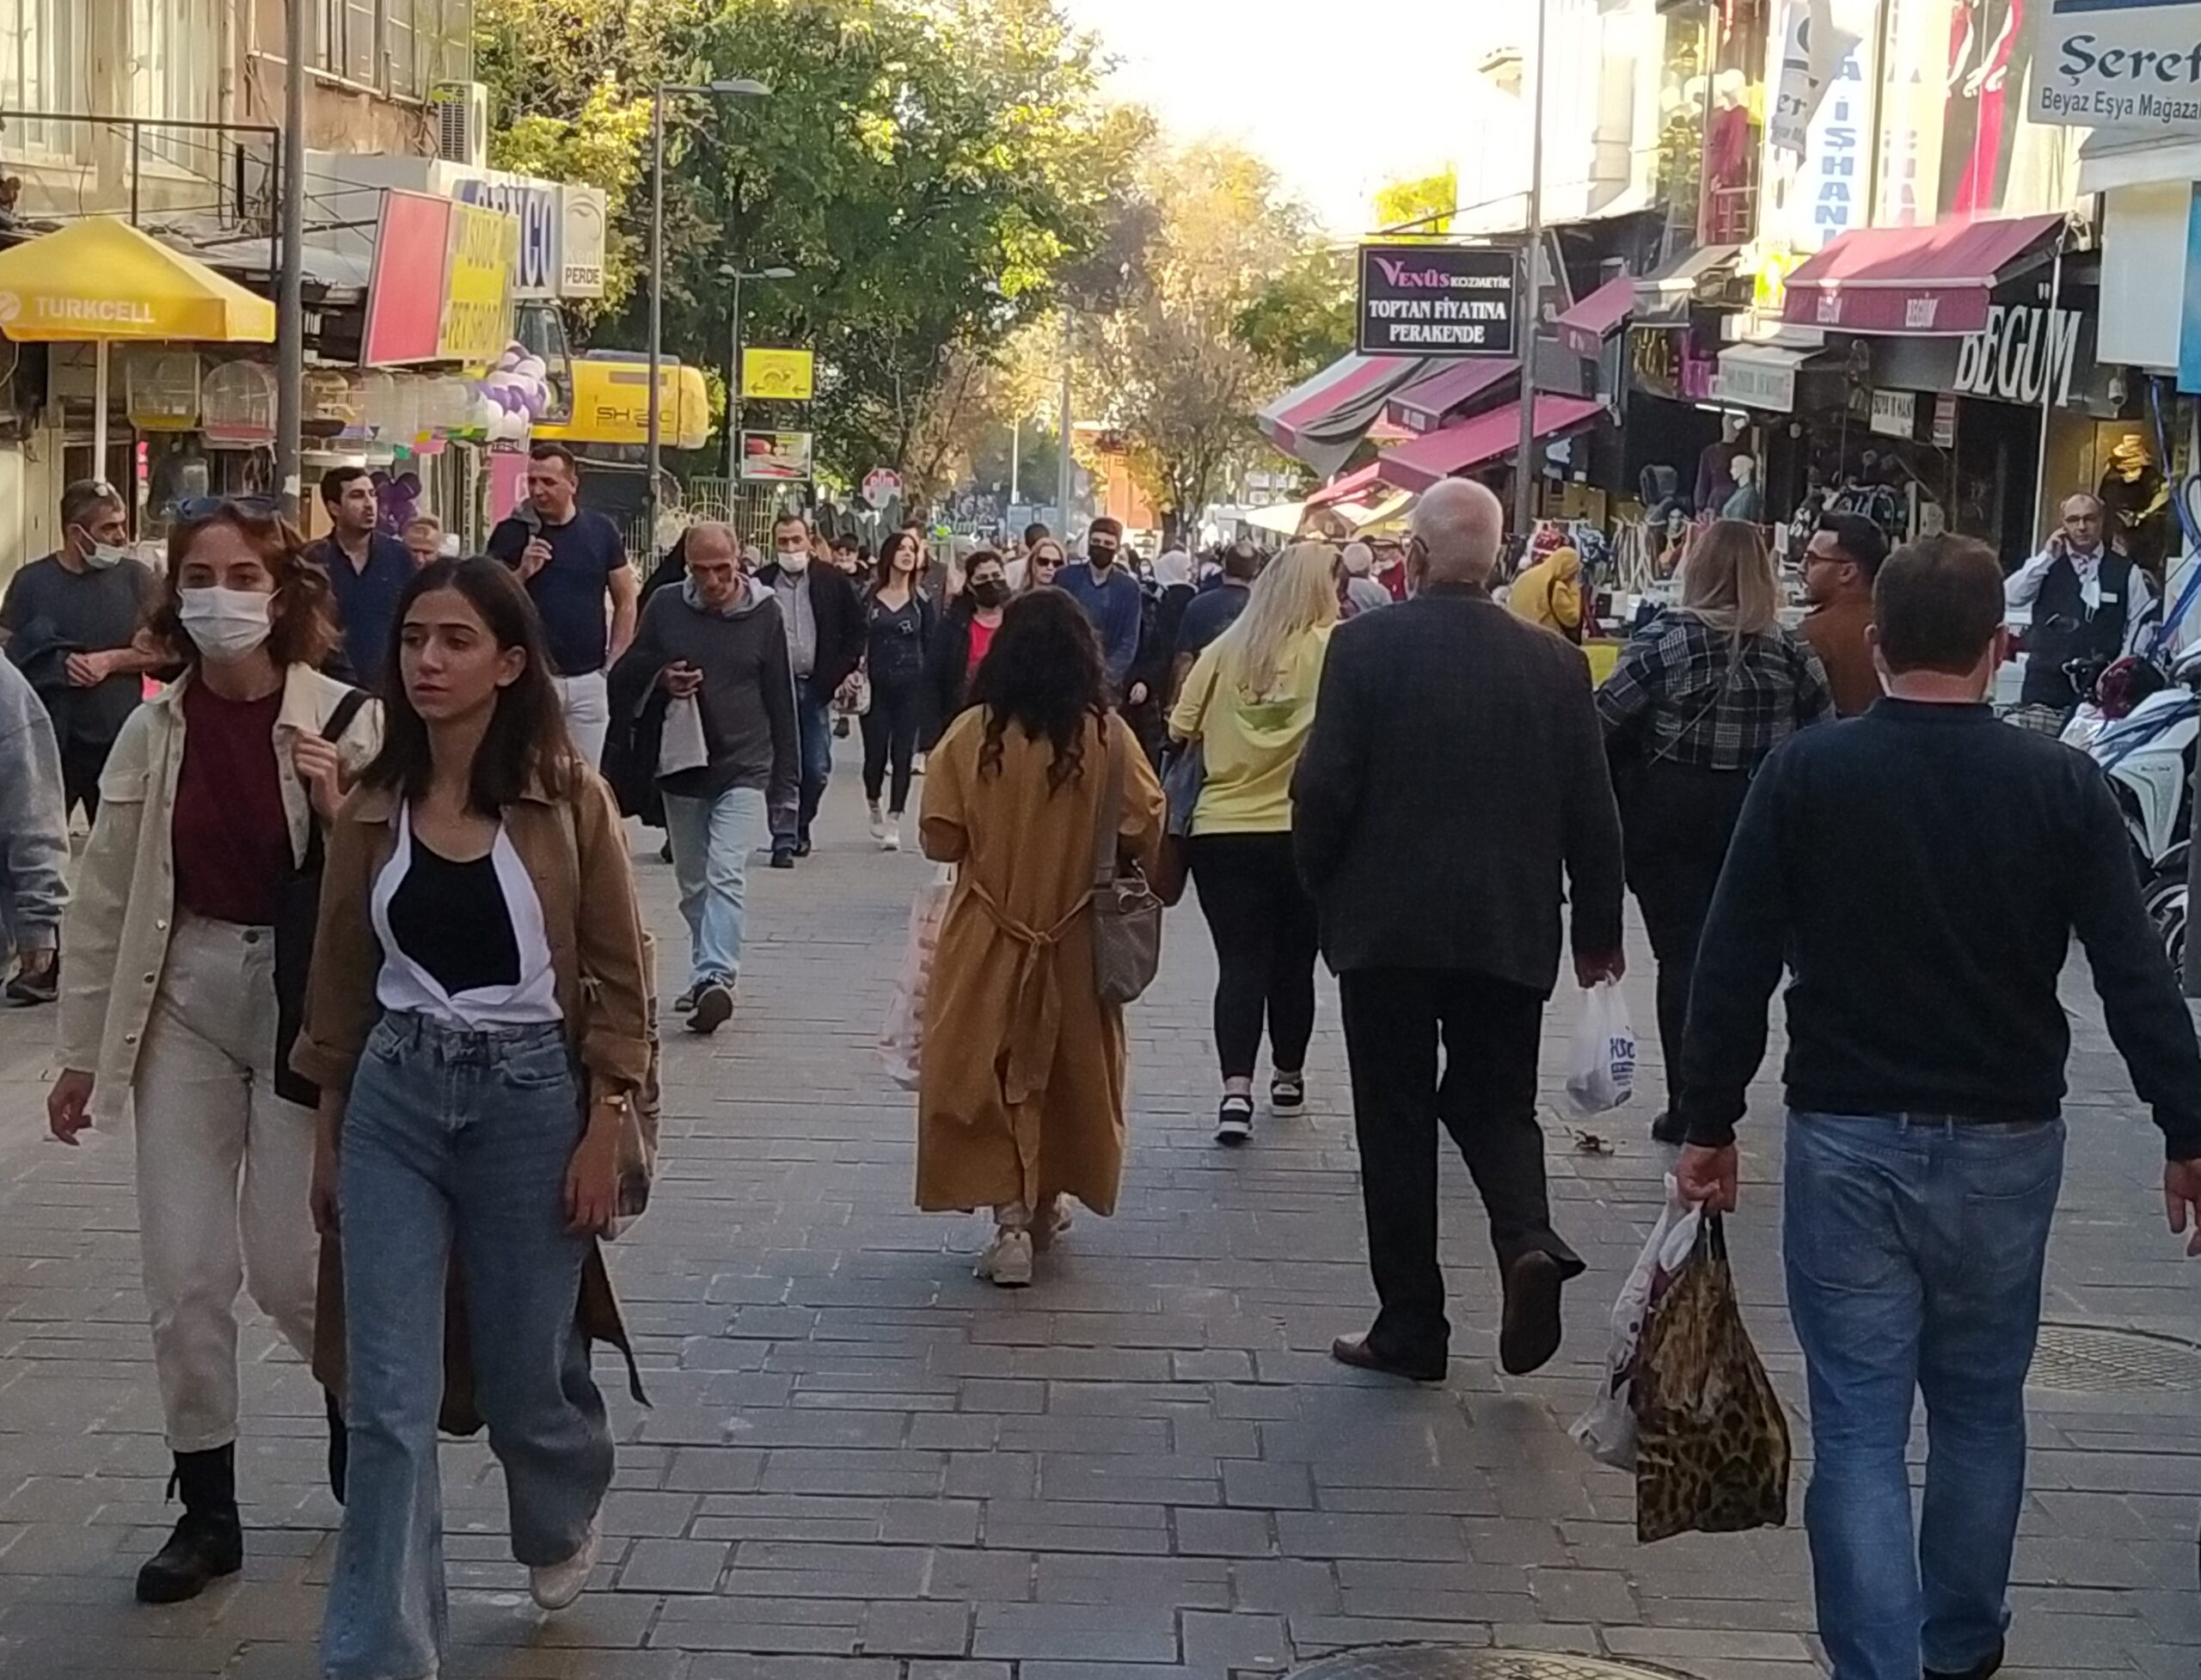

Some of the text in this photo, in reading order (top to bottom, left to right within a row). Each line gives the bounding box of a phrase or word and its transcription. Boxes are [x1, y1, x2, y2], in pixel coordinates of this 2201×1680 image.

[2059, 35, 2201, 86] Şeref
[2042, 87, 2090, 116] Beyaz
[2094, 90, 2134, 120] Eşya
[565, 267, 600, 285] PERDE
[1450, 275, 1511, 289] KOZMETİK
[35, 296, 156, 323] TURKCELL
[1369, 297, 1507, 321] TOPTAN FİYATINA
[1389, 324, 1485, 343] PERAKENDE
[1953, 282, 2083, 408] BEGÜM
